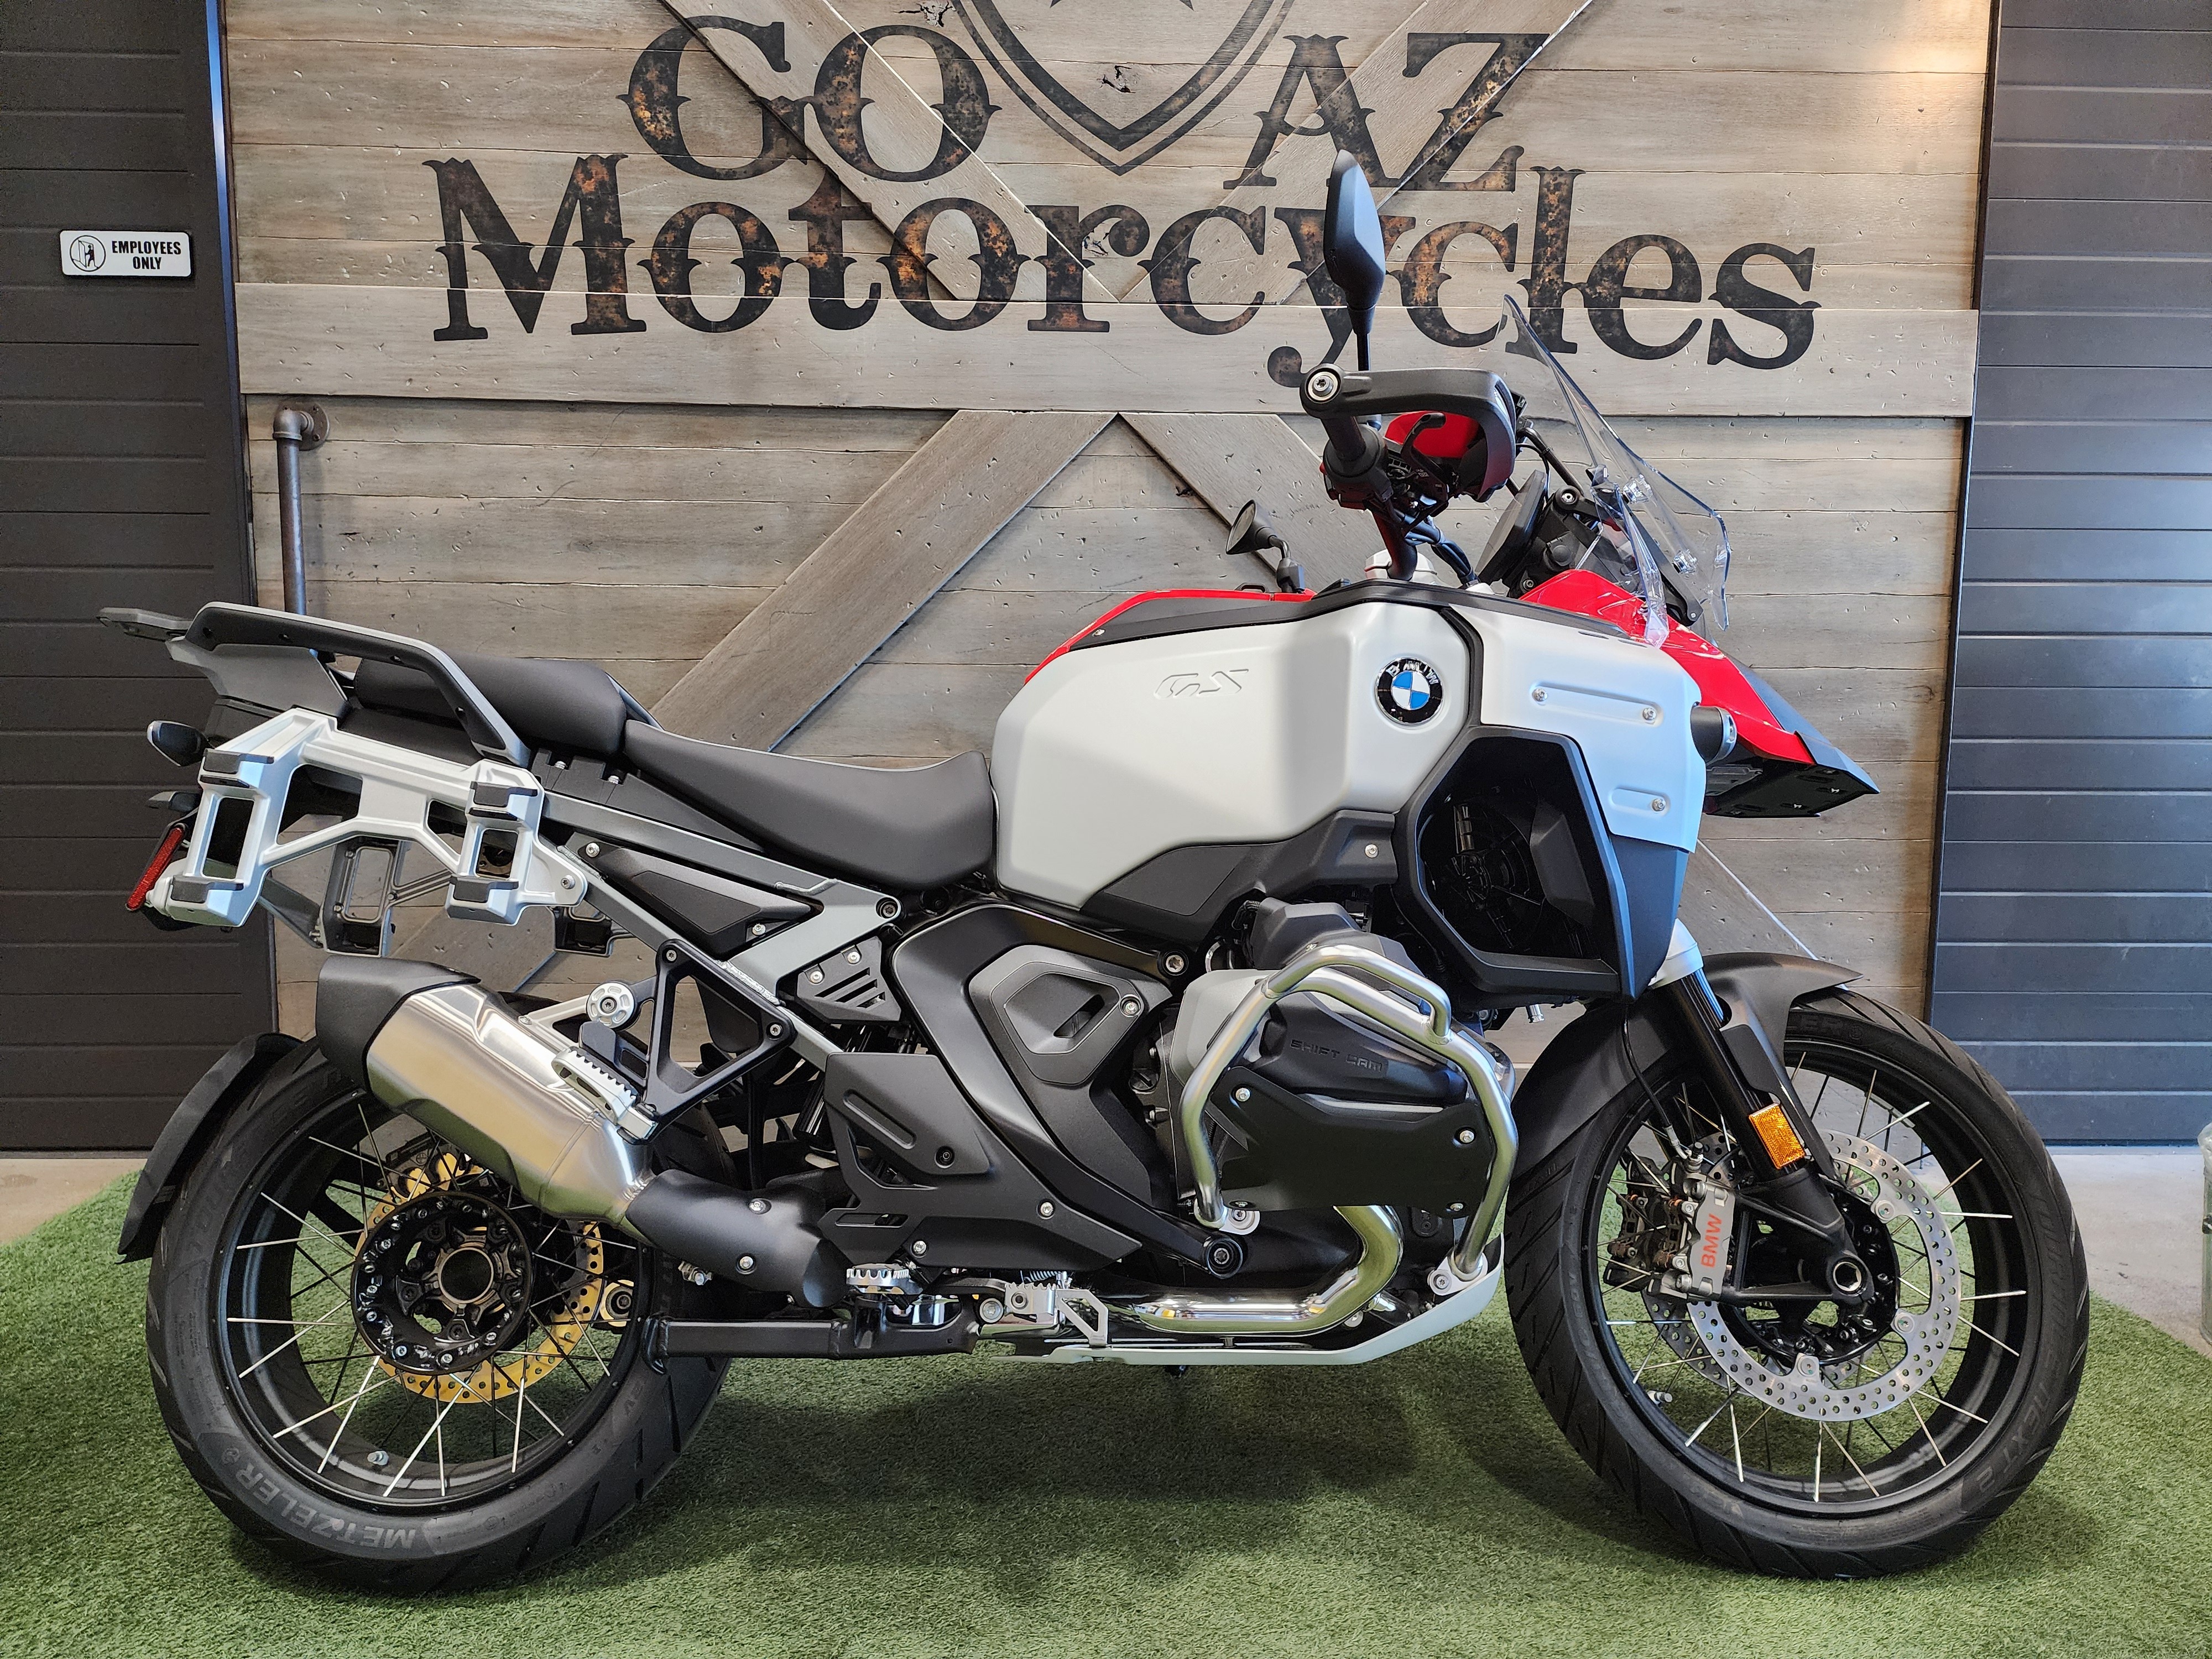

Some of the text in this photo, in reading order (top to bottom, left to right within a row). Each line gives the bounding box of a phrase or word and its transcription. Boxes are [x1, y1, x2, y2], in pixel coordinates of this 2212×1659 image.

[615, 15, 1551, 192] GO AZ
[112, 241, 181, 255] EMPLOYEES
[133, 256, 162, 269] ONLY
[422, 154, 1821, 387] Motorcycles
[1386, 661, 1439, 685] BMW
[1290, 1039, 1382, 1072] SHIFT CAM
[1702, 1214, 1722, 1267] BMW
[236, 1464, 416, 1549] METZELER
